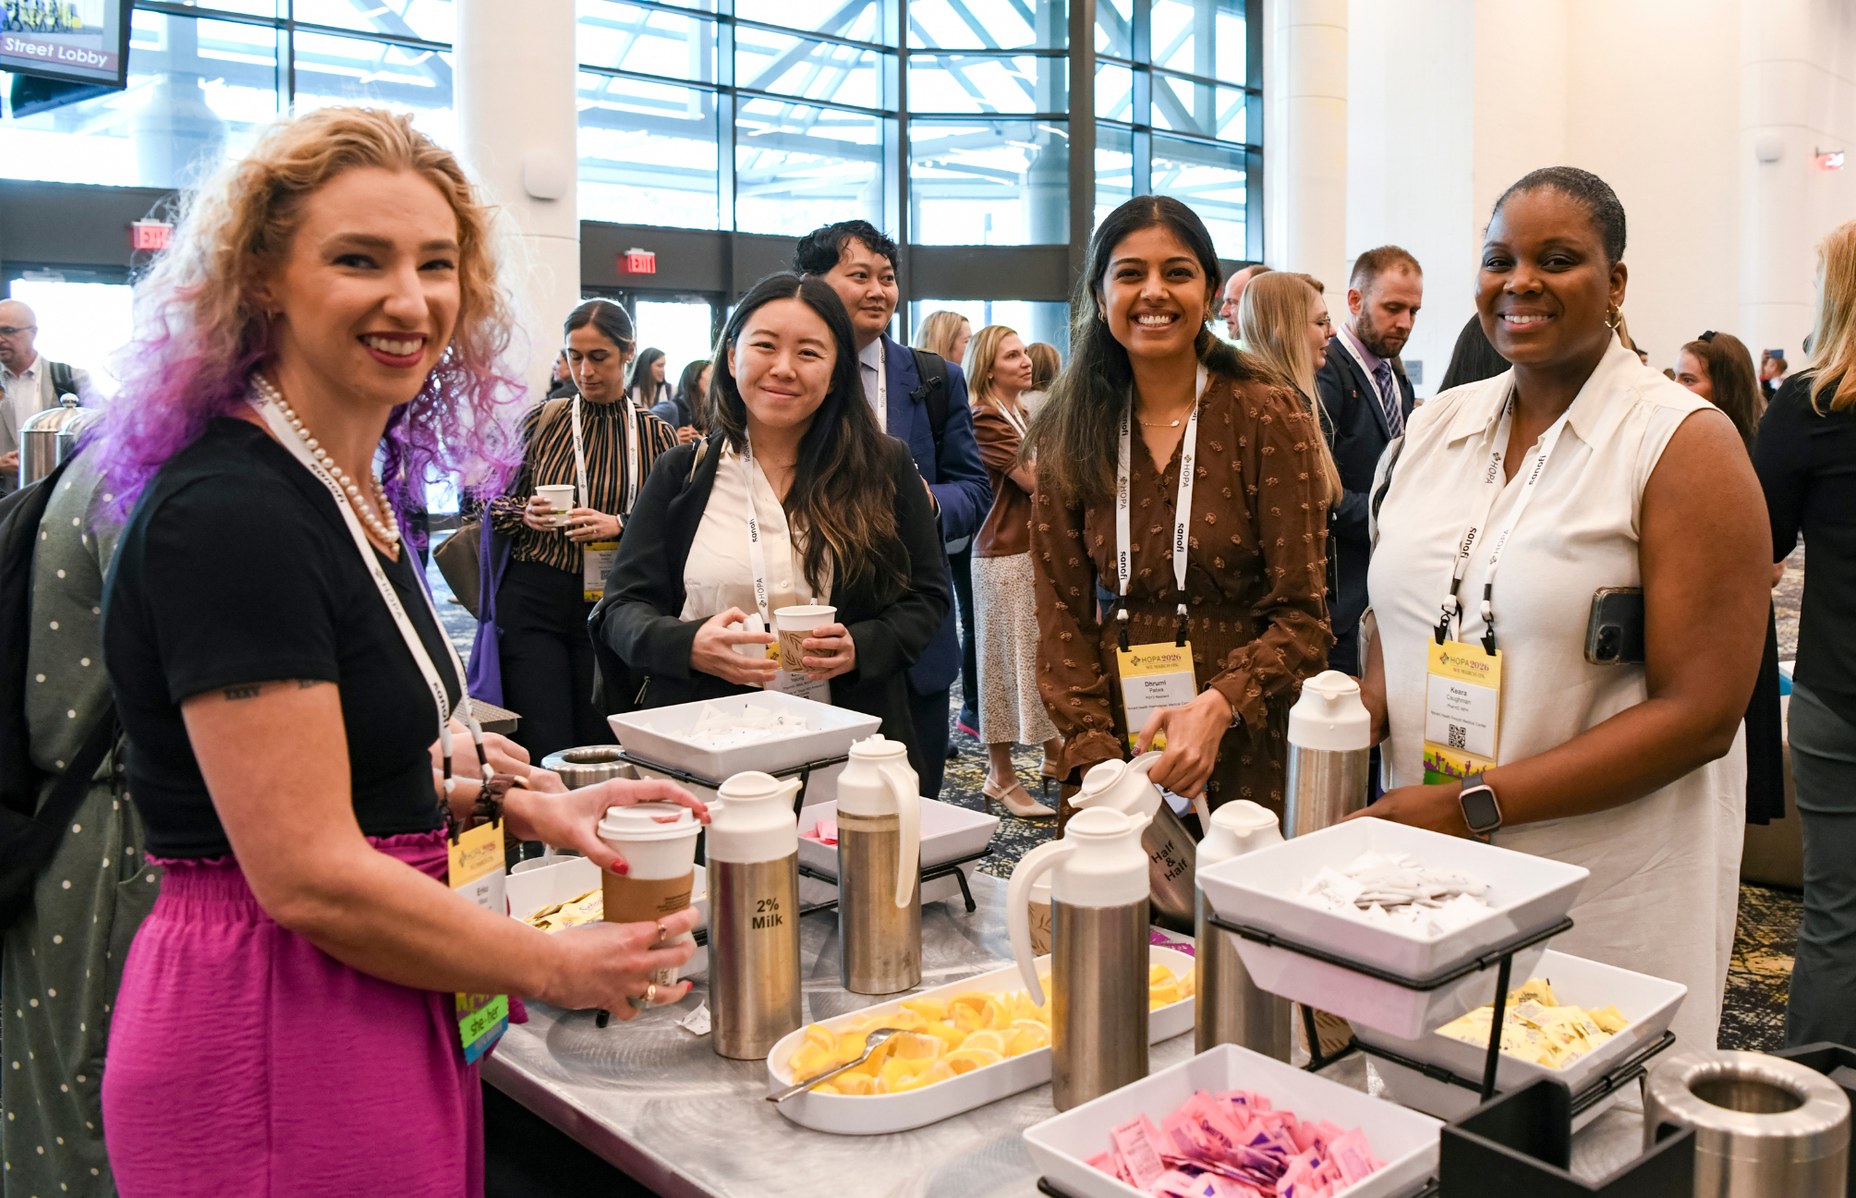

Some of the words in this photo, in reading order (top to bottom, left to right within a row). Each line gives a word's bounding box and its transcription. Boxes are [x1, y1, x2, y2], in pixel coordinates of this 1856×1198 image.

[5, 37, 54, 57] Street
[58, 46, 108, 67] Lobby
[630, 255, 656, 272] EXIT
[1121, 410, 1129, 436] anofi
[1182, 463, 1190, 488] HOPA
[1484, 460, 1499, 485] HOPA
[1528, 454, 1547, 486] sanofi
[310, 463, 345, 503] sanofi
[1119, 486, 1128, 510] HOPA
[750, 518, 759, 543] sanofi
[1176, 522, 1185, 553] sanofi
[1460, 526, 1478, 559] sanofi
[1119, 551, 1127, 580] sanofi
[381, 581, 402, 619] HOPA
[756, 577, 764, 600] HOPA
[1449, 686, 1468, 697] Keara
[432, 682, 450, 730] sanofi
[1151, 840, 1174, 864] Half
[1165, 857, 1176, 867] &
[1164, 858, 1187, 882] Half
[756, 897, 779, 913] 2%
[752, 913, 783, 929] Milk
